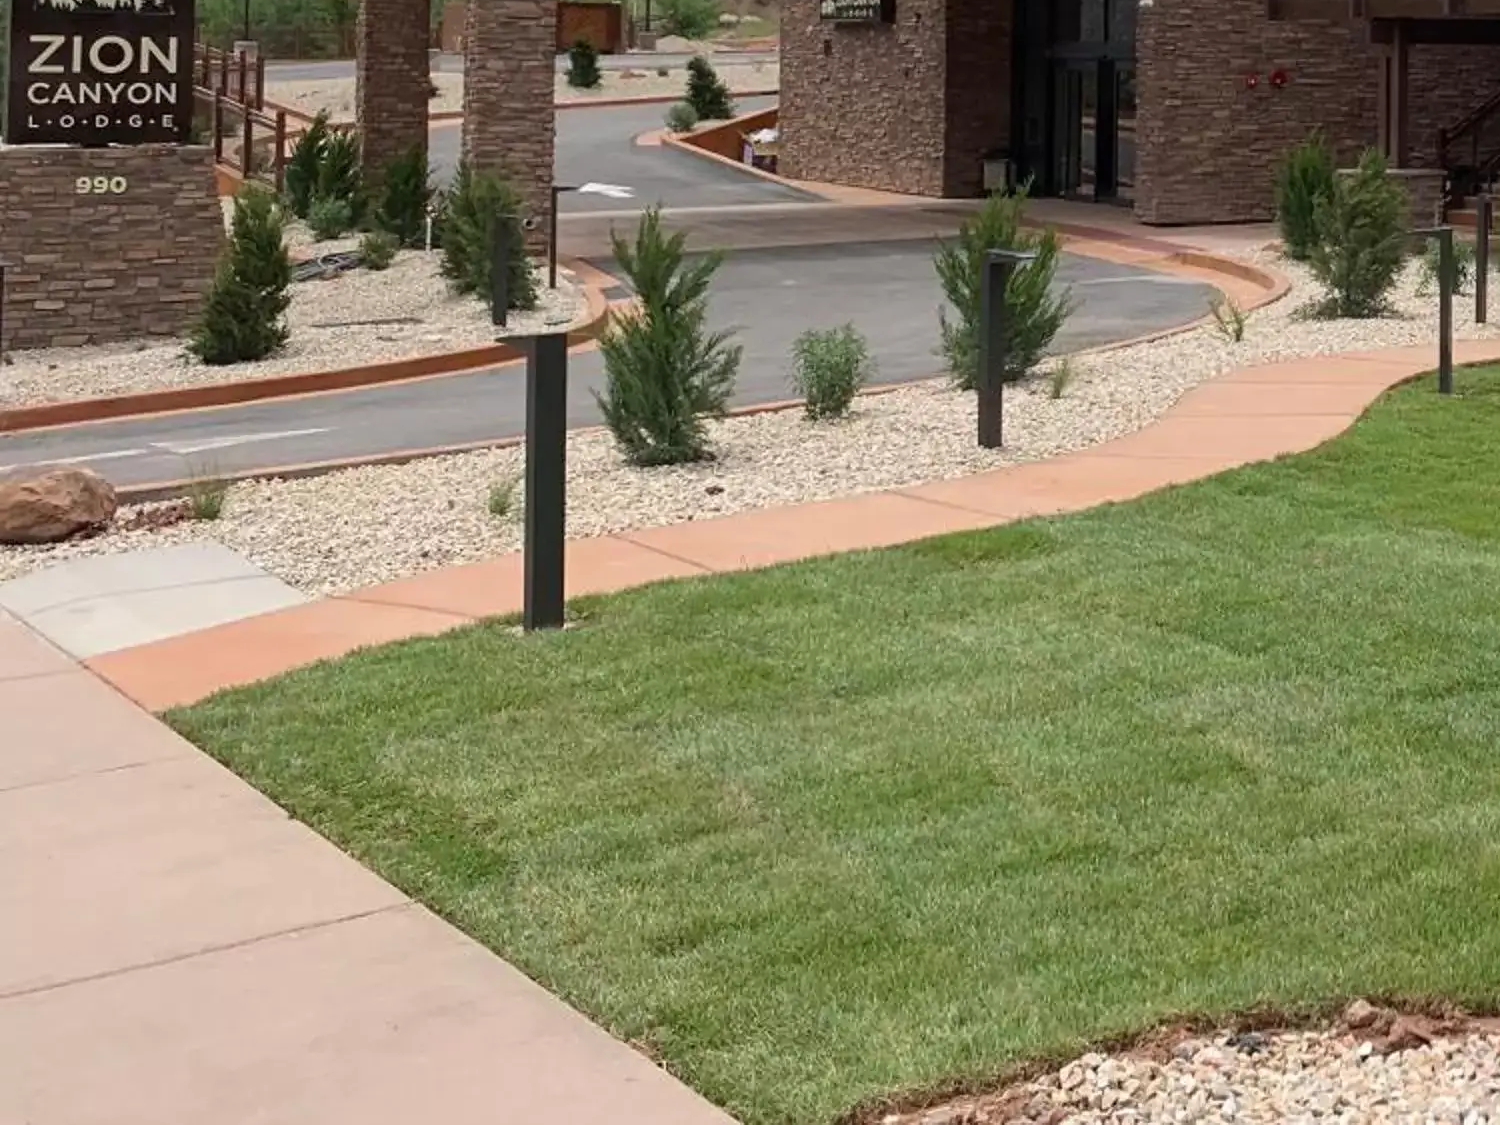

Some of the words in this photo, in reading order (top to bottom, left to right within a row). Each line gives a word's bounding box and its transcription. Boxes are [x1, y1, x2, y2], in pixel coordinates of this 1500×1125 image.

[28, 34, 178, 74] ZION
[27, 82, 177, 104] CANYON
[75, 176, 127, 194] 990
